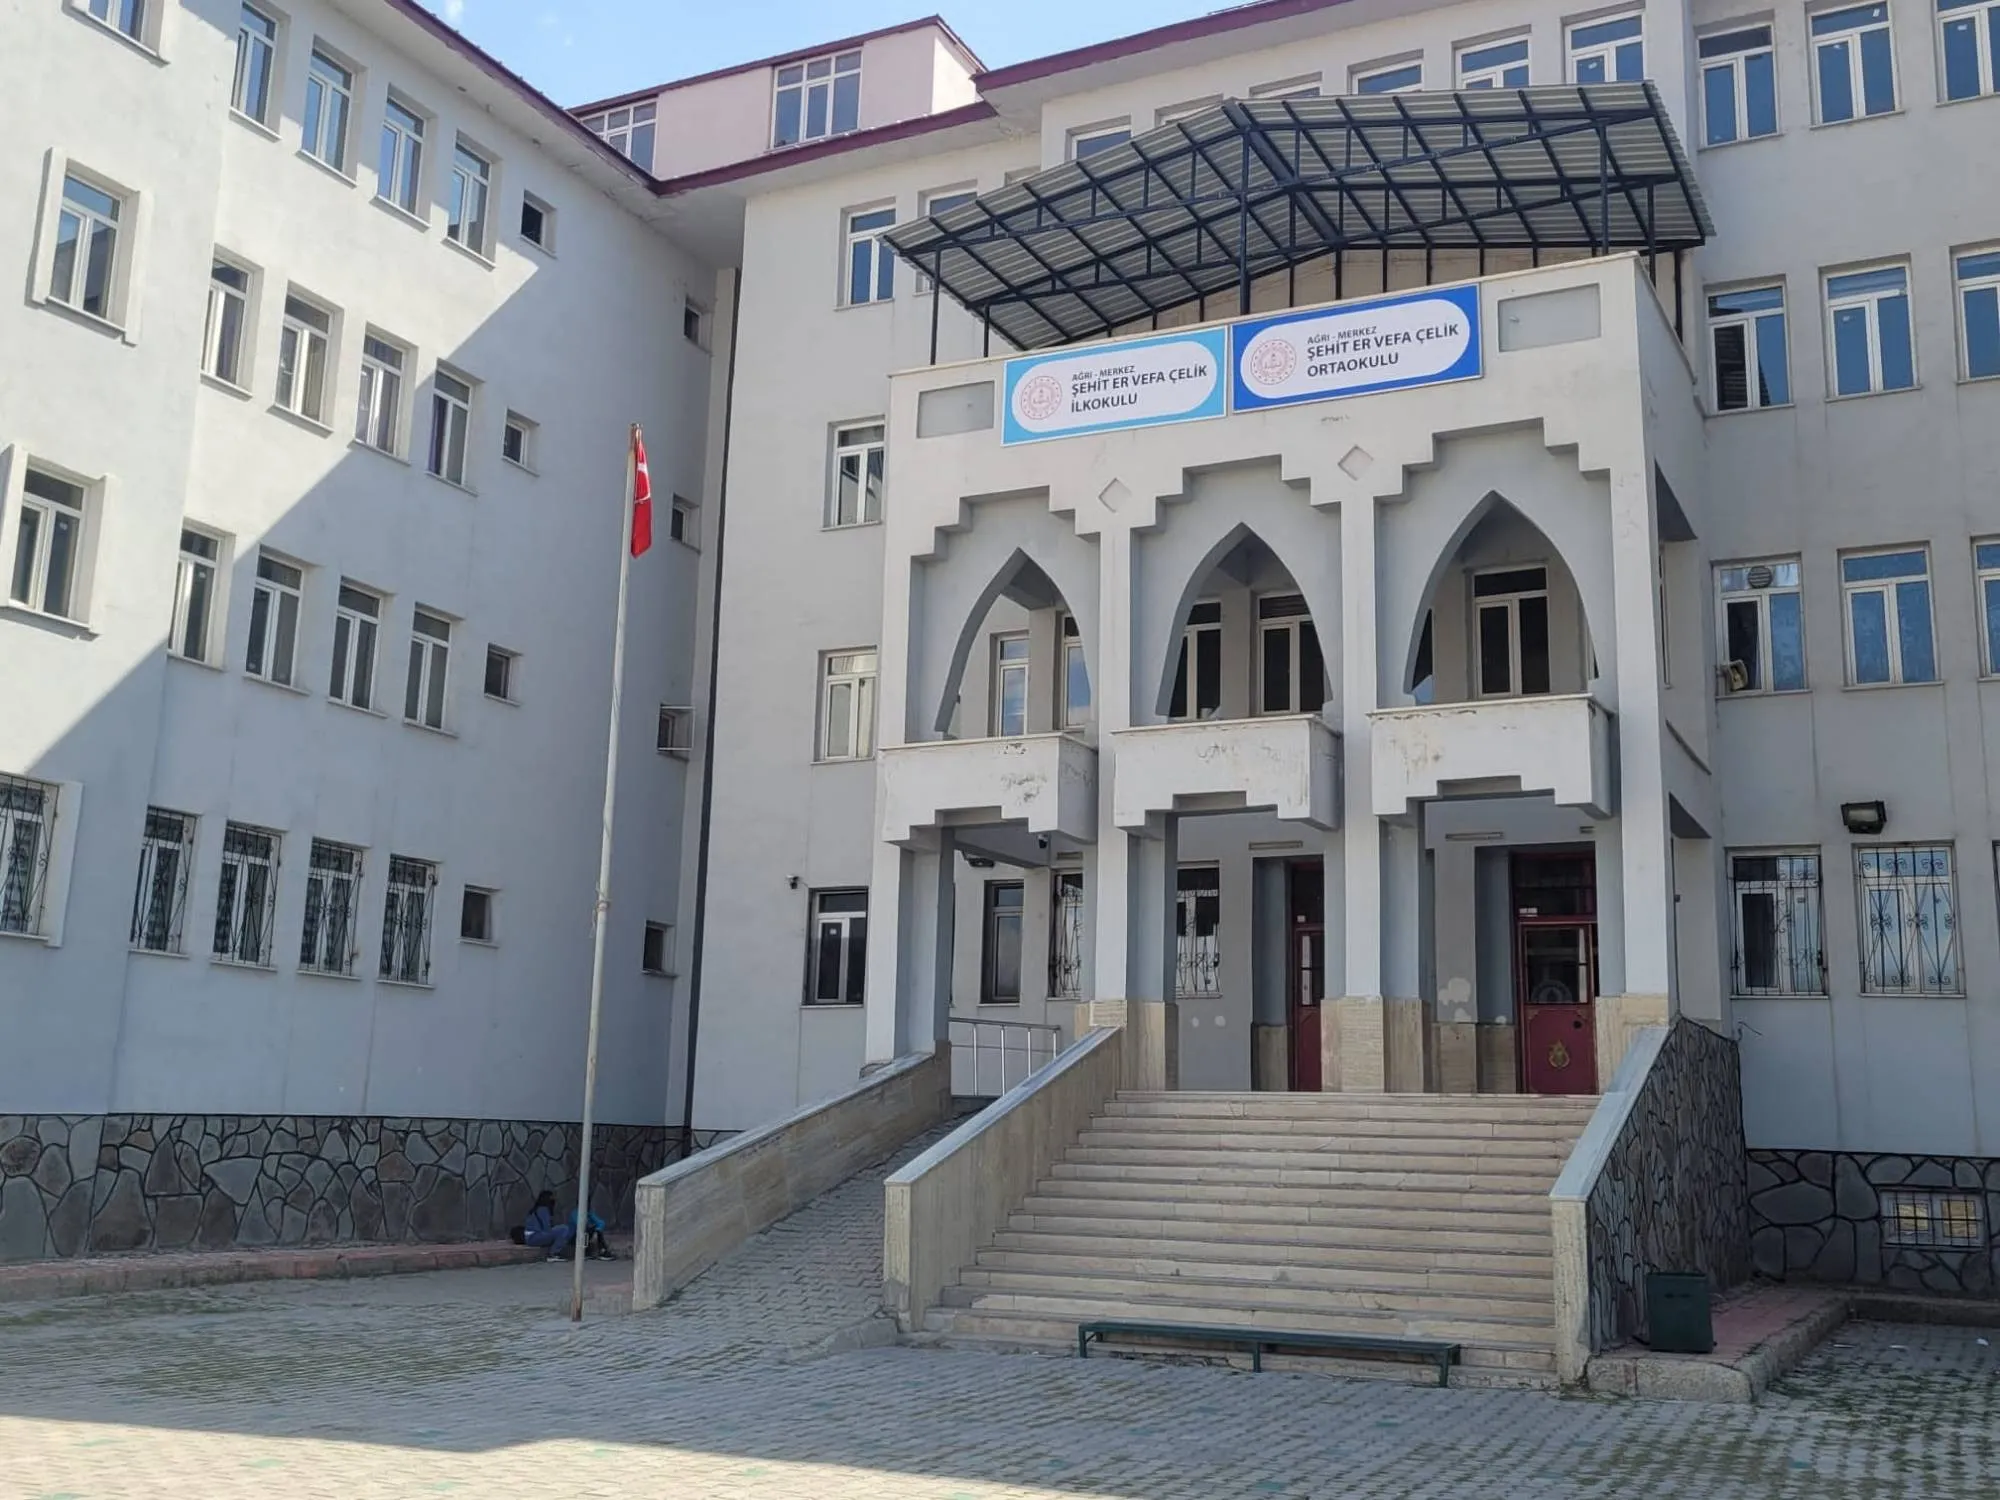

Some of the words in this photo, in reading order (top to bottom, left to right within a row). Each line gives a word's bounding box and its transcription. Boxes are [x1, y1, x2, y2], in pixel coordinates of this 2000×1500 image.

[1307, 333, 1330, 344] AĞRI
[1338, 326, 1377, 339] MERKEZ
[1307, 341, 1349, 360] ŞEHİT
[1354, 339, 1371, 352] ER
[1375, 332, 1412, 347] VEFA
[1416, 324, 1459, 345] ÇELİK
[1072, 372, 1093, 381] AĞRI
[1100, 365, 1135, 376] MERKEZ
[1307, 353, 1399, 376] ORTAOKULU
[1071, 378, 1109, 396] ŞEHİT
[1113, 377, 1128, 389] ER
[1131, 372, 1165, 386] VEFA
[1169, 365, 1207, 384] ÇELİK
[1071, 393, 1137, 413] İLKOKULU
